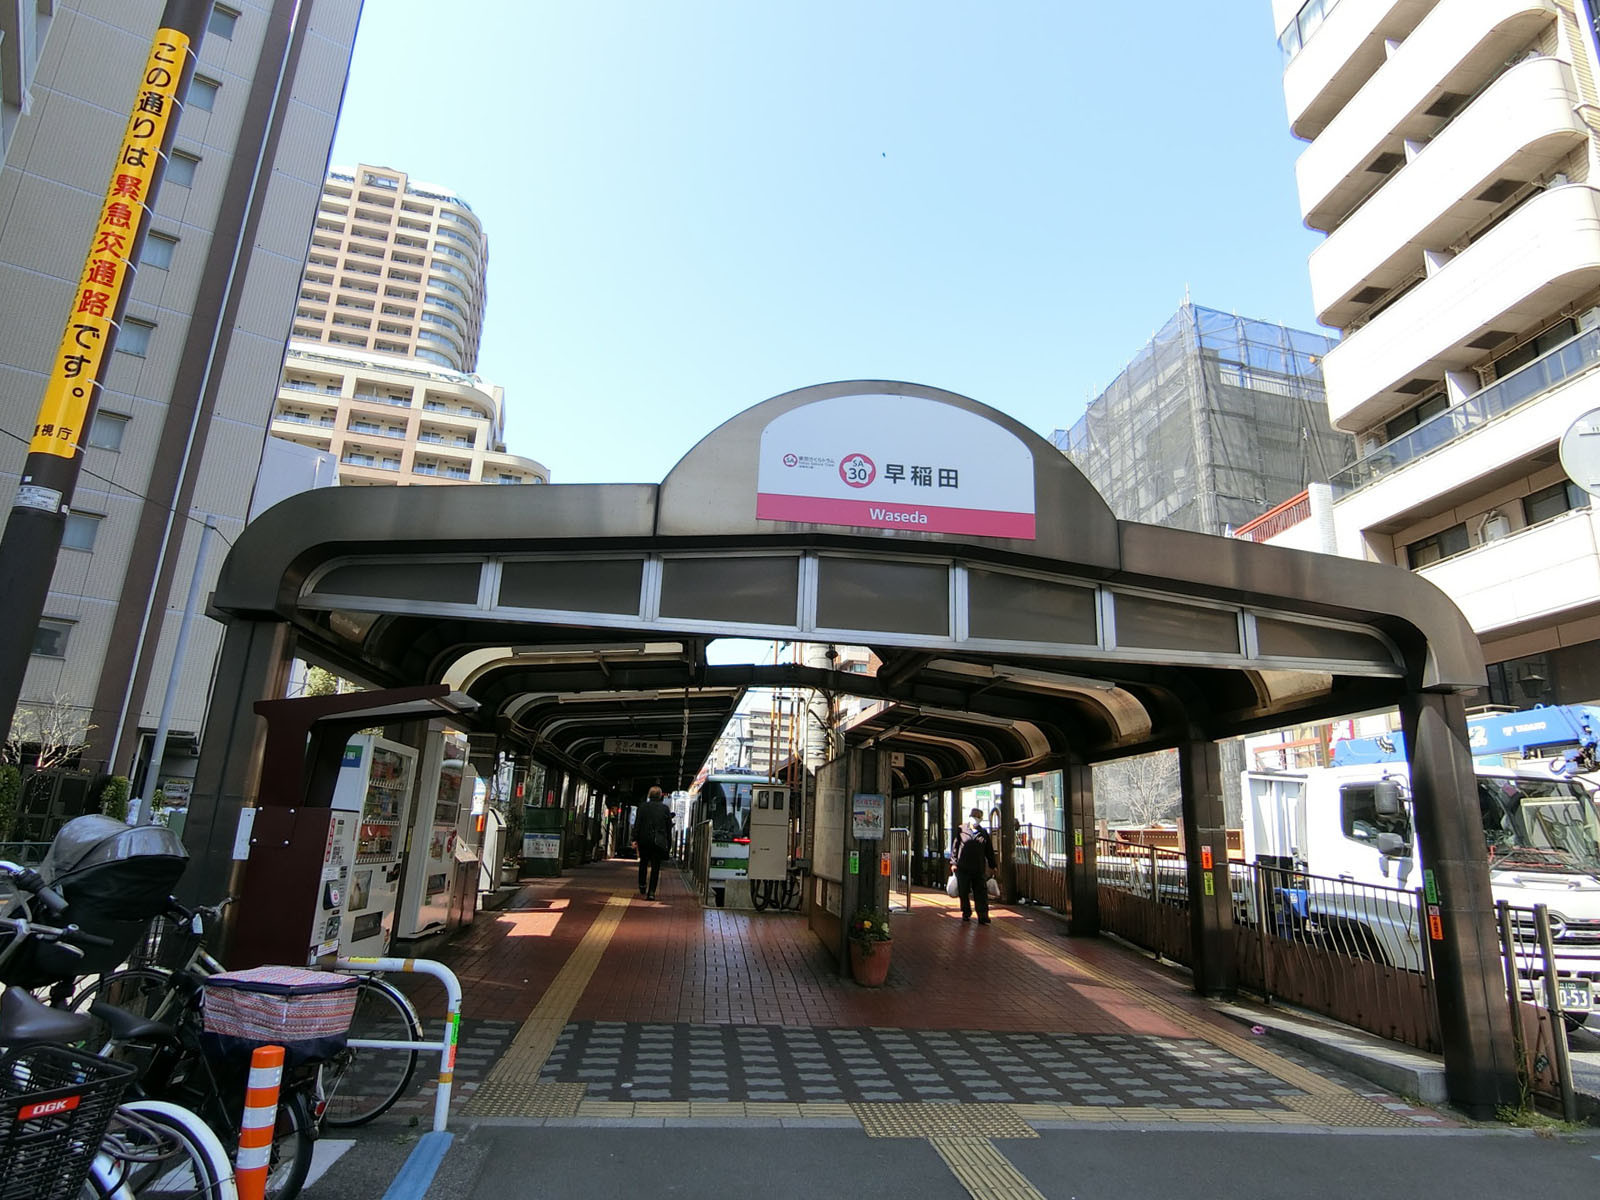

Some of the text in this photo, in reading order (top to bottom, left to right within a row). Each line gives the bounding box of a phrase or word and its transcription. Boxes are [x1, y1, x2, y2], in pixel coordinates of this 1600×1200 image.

[64, 43, 177, 398] この通りは緊急交通路です。
[852, 460, 865, 468] SA
[848, 468, 867, 481] 30
[884, 463, 959, 489] 早稲田
[869, 508, 928, 525] Waseda
[1559, 990, 1588, 1007] 0-53
[32, 1100, 68, 1115] OGK
